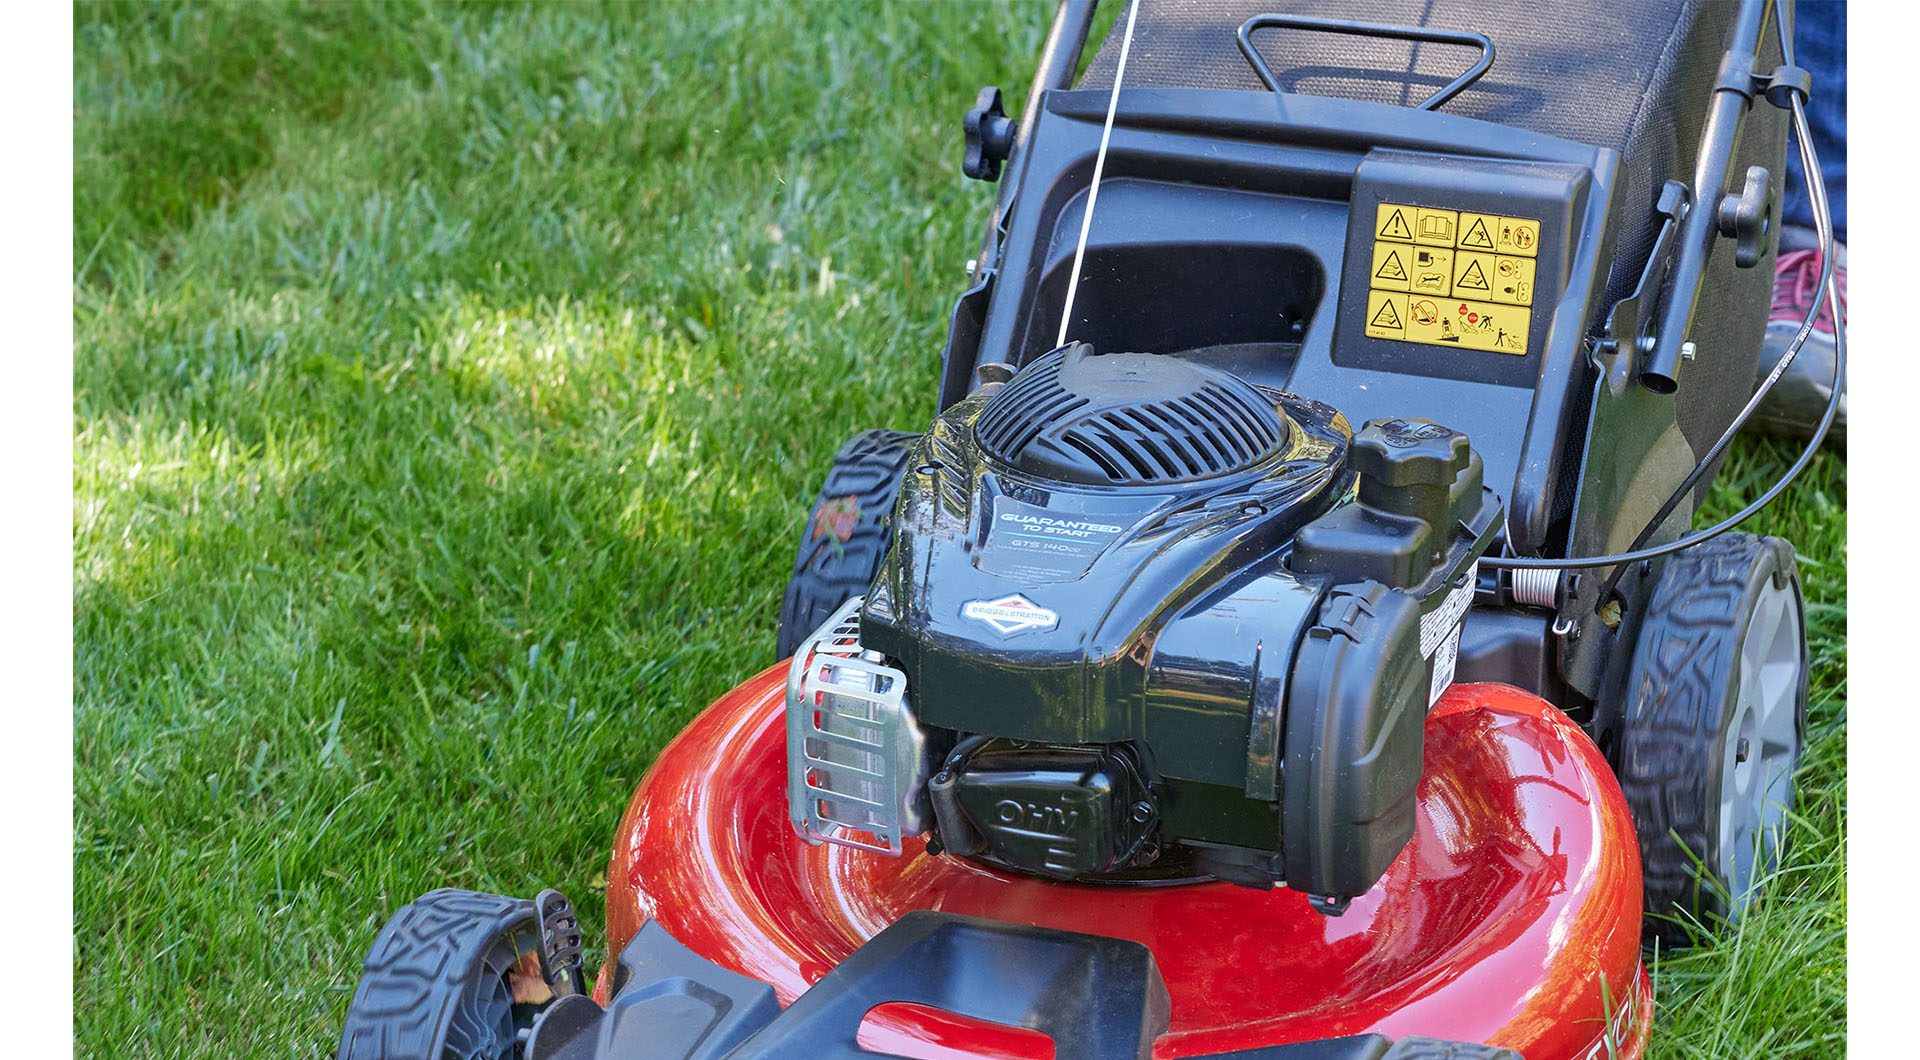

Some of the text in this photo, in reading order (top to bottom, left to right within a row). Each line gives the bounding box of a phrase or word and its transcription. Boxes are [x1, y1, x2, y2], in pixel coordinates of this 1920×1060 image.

[1001, 513, 1122, 533] GUARANTEED
[1023, 524, 1092, 537] TO START
[1012, 540, 1040, 549] GTS
